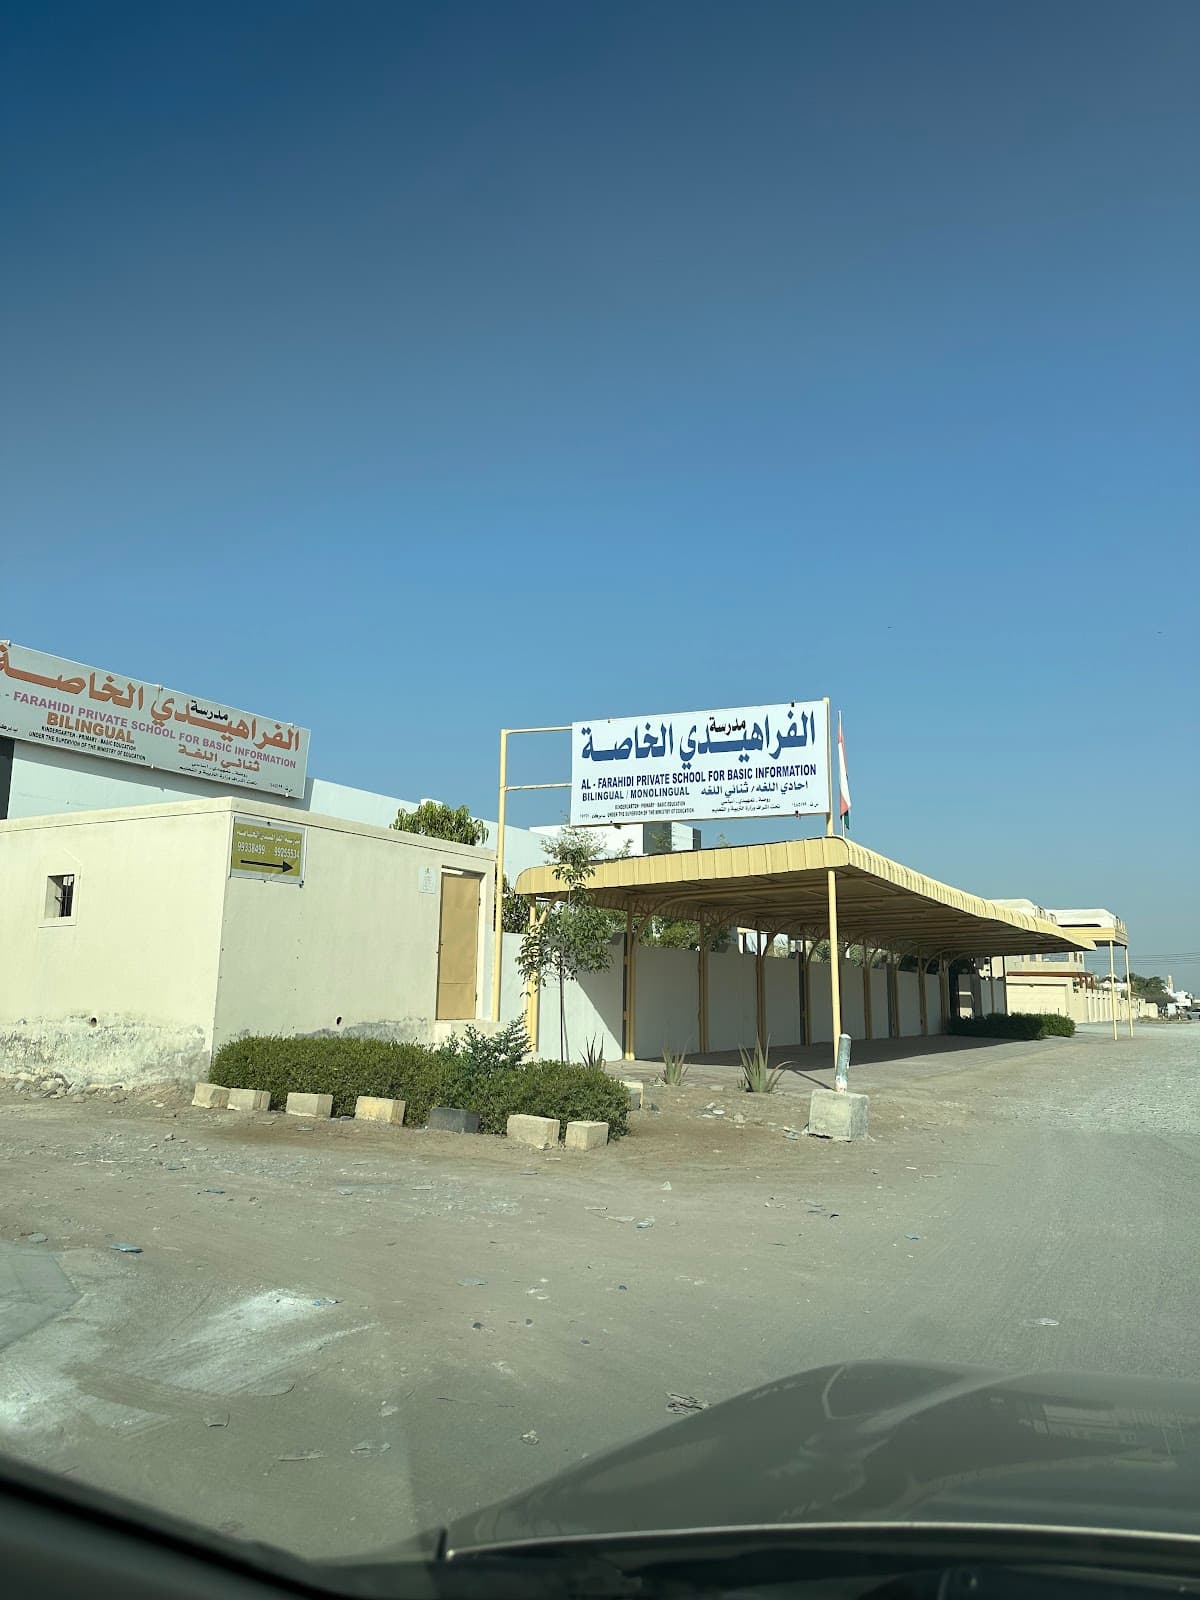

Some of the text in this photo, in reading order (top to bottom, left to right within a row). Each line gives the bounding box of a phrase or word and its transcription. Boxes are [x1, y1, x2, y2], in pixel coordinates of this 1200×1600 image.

[190, 700, 228, 720] مدرسة
[14, 691, 74, 714] FARAHIDI
[78, 708, 128, 728] PRIVATE
[132, 720, 176, 740] SCHOOL
[179, 732, 200, 744] FOR
[202, 738, 232, 752] BASIC
[234, 746, 296, 768] INFORMATION
[47, 712, 134, 744] BILINGUAL
[151, 698, 300, 752] الفراهيدي
[710, 717, 746, 736] مدرسة
[581, 710, 816, 770] الفراهيدي الخاصة
[581, 778, 591, 790] AL
[598, 776, 634, 788] FARAHIDI
[636, 773, 670, 786] PRIVATE
[672, 771, 706, 784] SCHOOL
[708, 770, 725, 782] FOR
[728, 768, 753, 780] BASIC
[756, 764, 816, 778] INFORMATION
[582, 790, 624, 802] BILINGUAL
[630, 786, 690, 799] MONOLINGUAL
